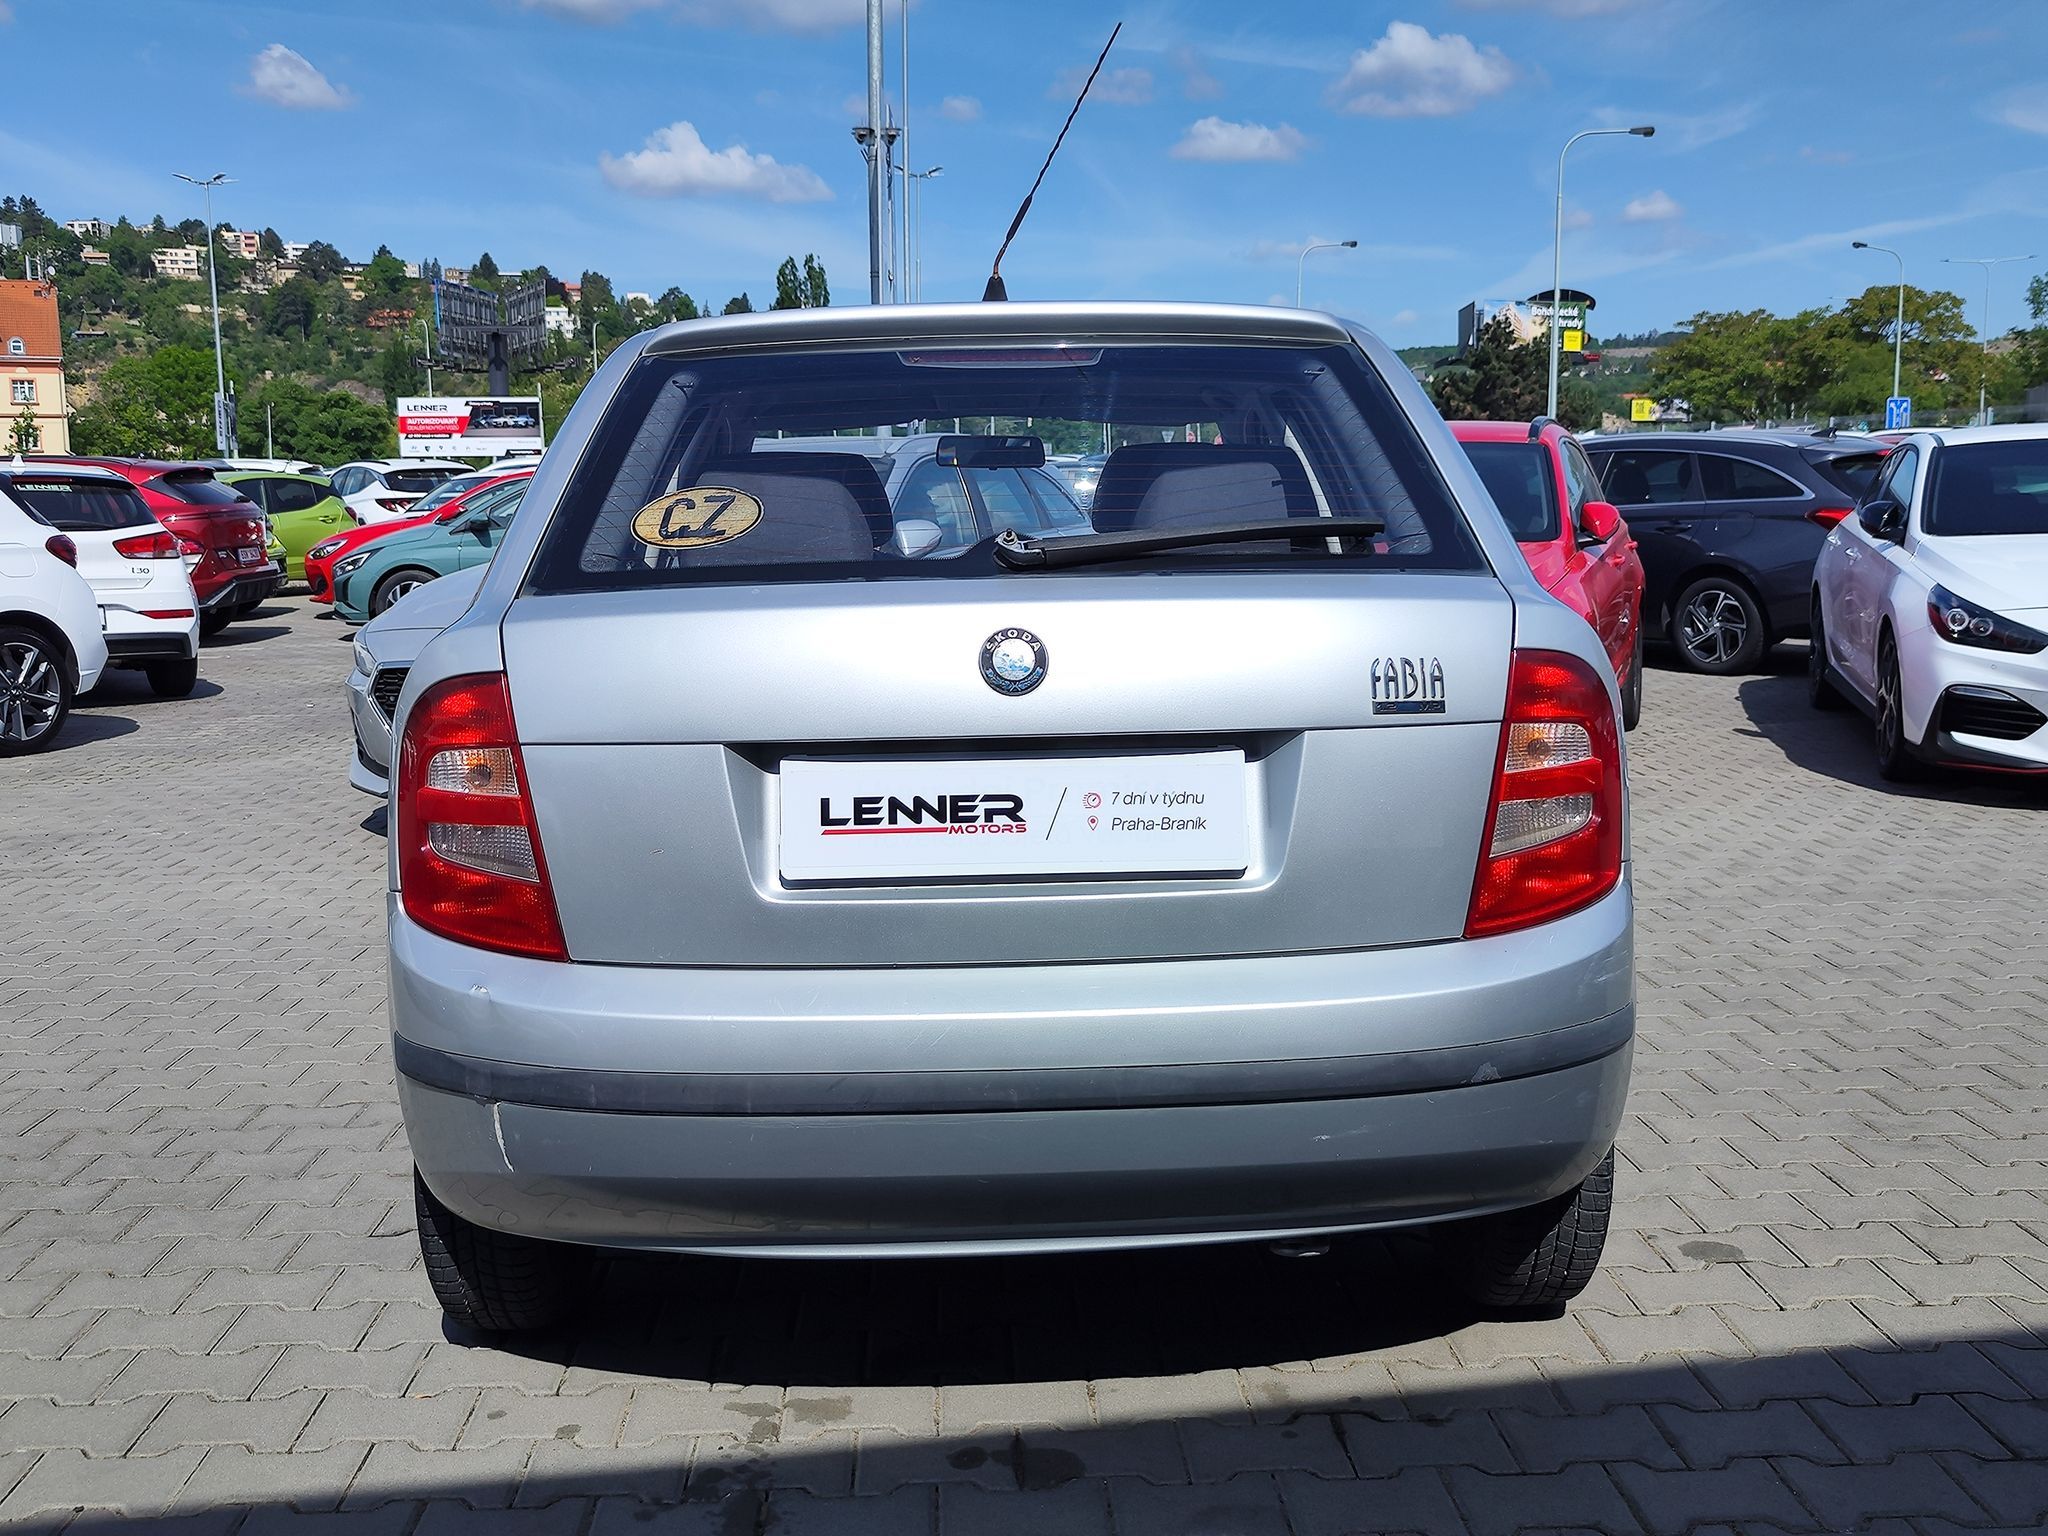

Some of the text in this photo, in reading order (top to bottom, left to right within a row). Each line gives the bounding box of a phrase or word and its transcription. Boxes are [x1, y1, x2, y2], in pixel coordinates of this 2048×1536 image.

[1531, 305, 1579, 317] Bohdecké
[1549, 317, 1583, 330] zhrady
[407, 404, 448, 412] LENNER
[659, 495, 736, 539] CZ
[1370, 657, 1445, 700] FABIA
[1112, 790, 1205, 808] 7 dní v týdnu
[820, 793, 1027, 826] LENNER
[948, 823, 1027, 834] MOTORS
[1111, 816, 1207, 831] Praha-Braník
